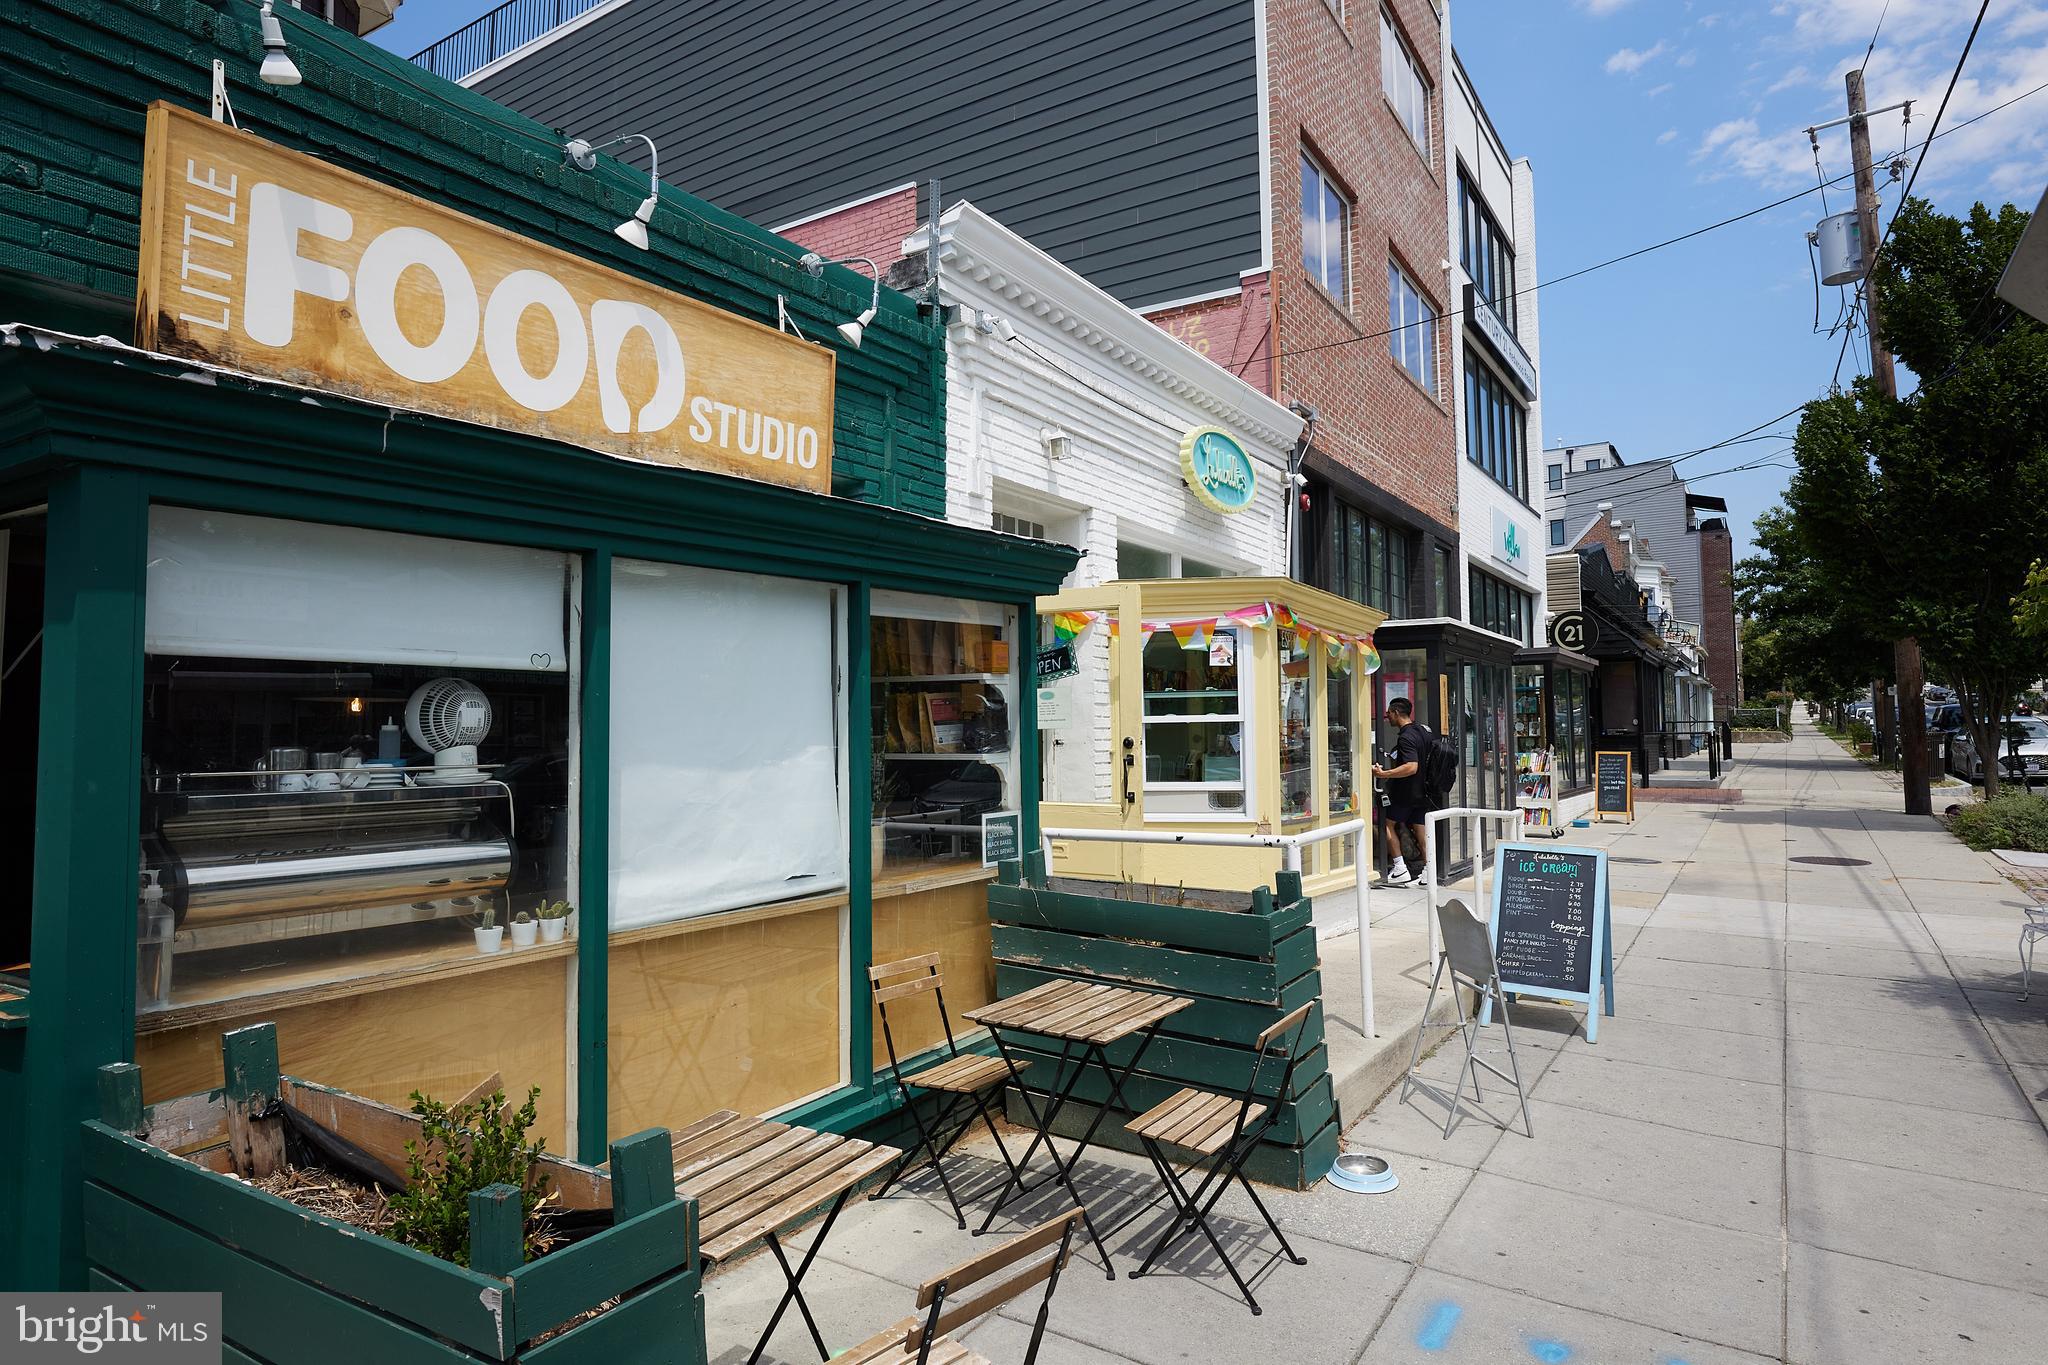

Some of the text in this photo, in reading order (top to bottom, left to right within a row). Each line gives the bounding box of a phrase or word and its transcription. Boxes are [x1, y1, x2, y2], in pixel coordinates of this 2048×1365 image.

[179, 158, 238, 331] LITTLE
[243, 181, 686, 434] FOOD
[1476, 300, 1502, 346] CENTURY
[688, 395, 818, 469] STUDIO
[1036, 656, 1062, 675] PEN
[1550, 920, 1586, 938] toppings
